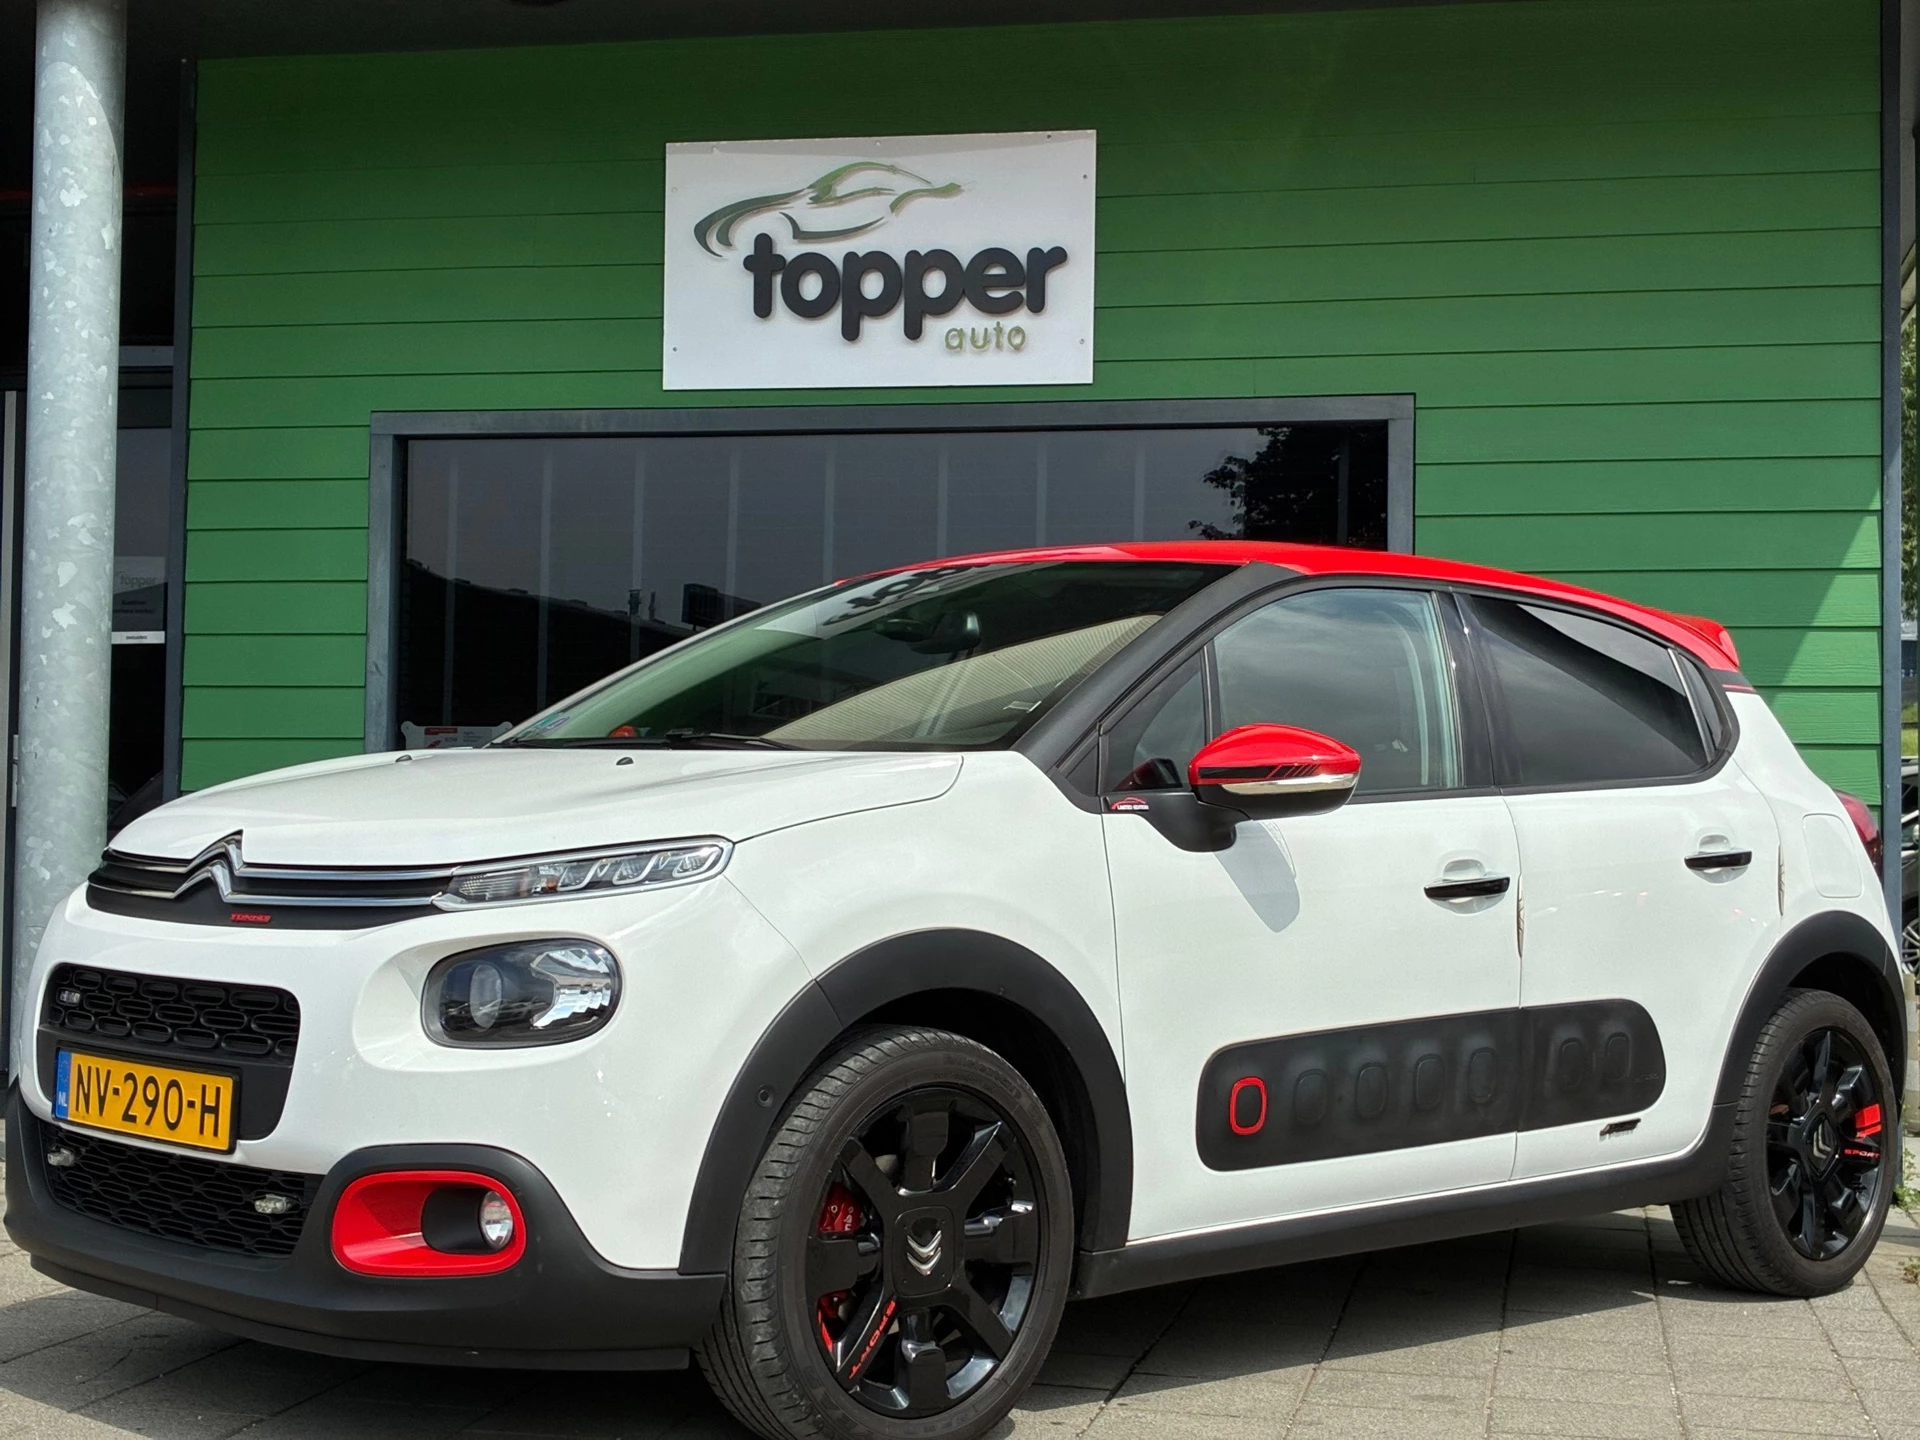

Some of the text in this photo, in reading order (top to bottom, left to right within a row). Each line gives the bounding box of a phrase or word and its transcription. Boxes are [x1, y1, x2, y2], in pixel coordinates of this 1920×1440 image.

[743, 232, 1068, 342] topper
[944, 320, 1027, 351] auto
[58, 1091, 68, 1107] NL
[75, 1063, 222, 1138] NV-290-H
[1844, 1148, 1880, 1158] SPORT
